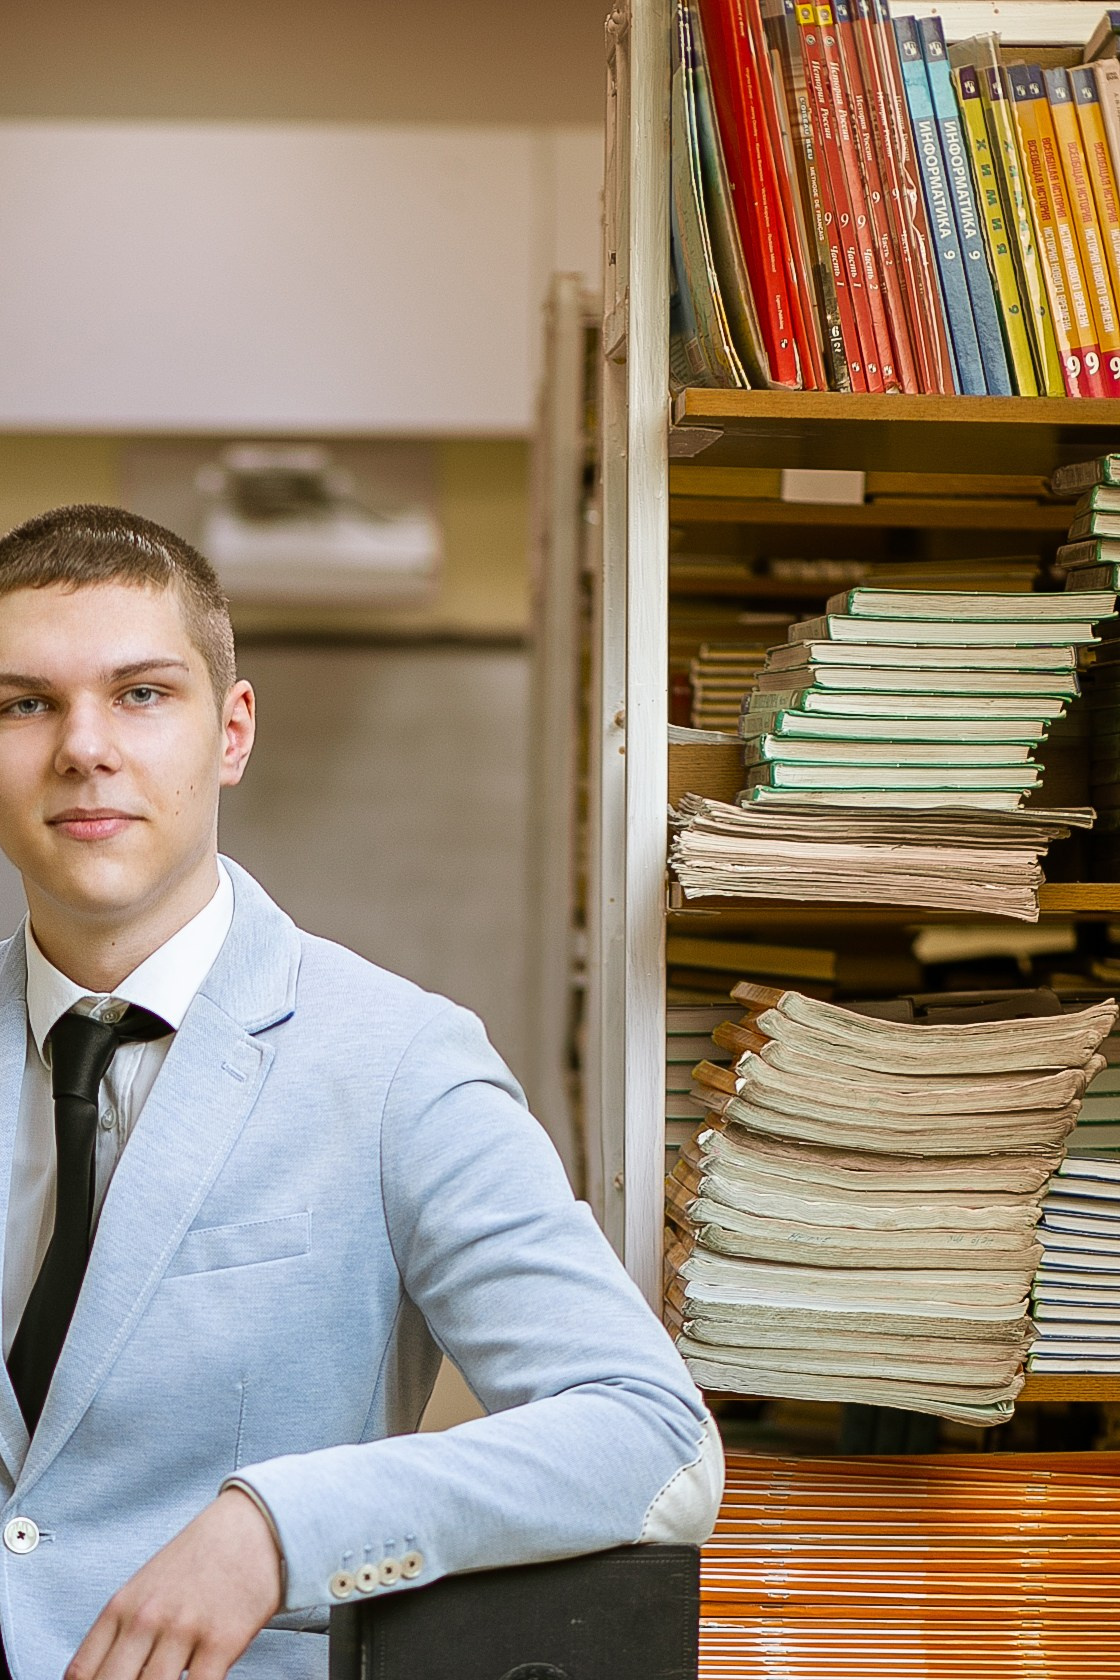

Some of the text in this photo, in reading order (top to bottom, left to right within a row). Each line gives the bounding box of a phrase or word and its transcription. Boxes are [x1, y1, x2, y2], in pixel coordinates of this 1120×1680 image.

[918, 121, 955, 260] ИНФОРМАТИКА 9
[944, 121, 980, 260] ИНФОРМАТИКА 9
[841, 213, 849, 227] 9
[857, 215, 866, 229] 9
[1067, 356, 1081, 378] 9
[1086, 352, 1099, 374] 9
